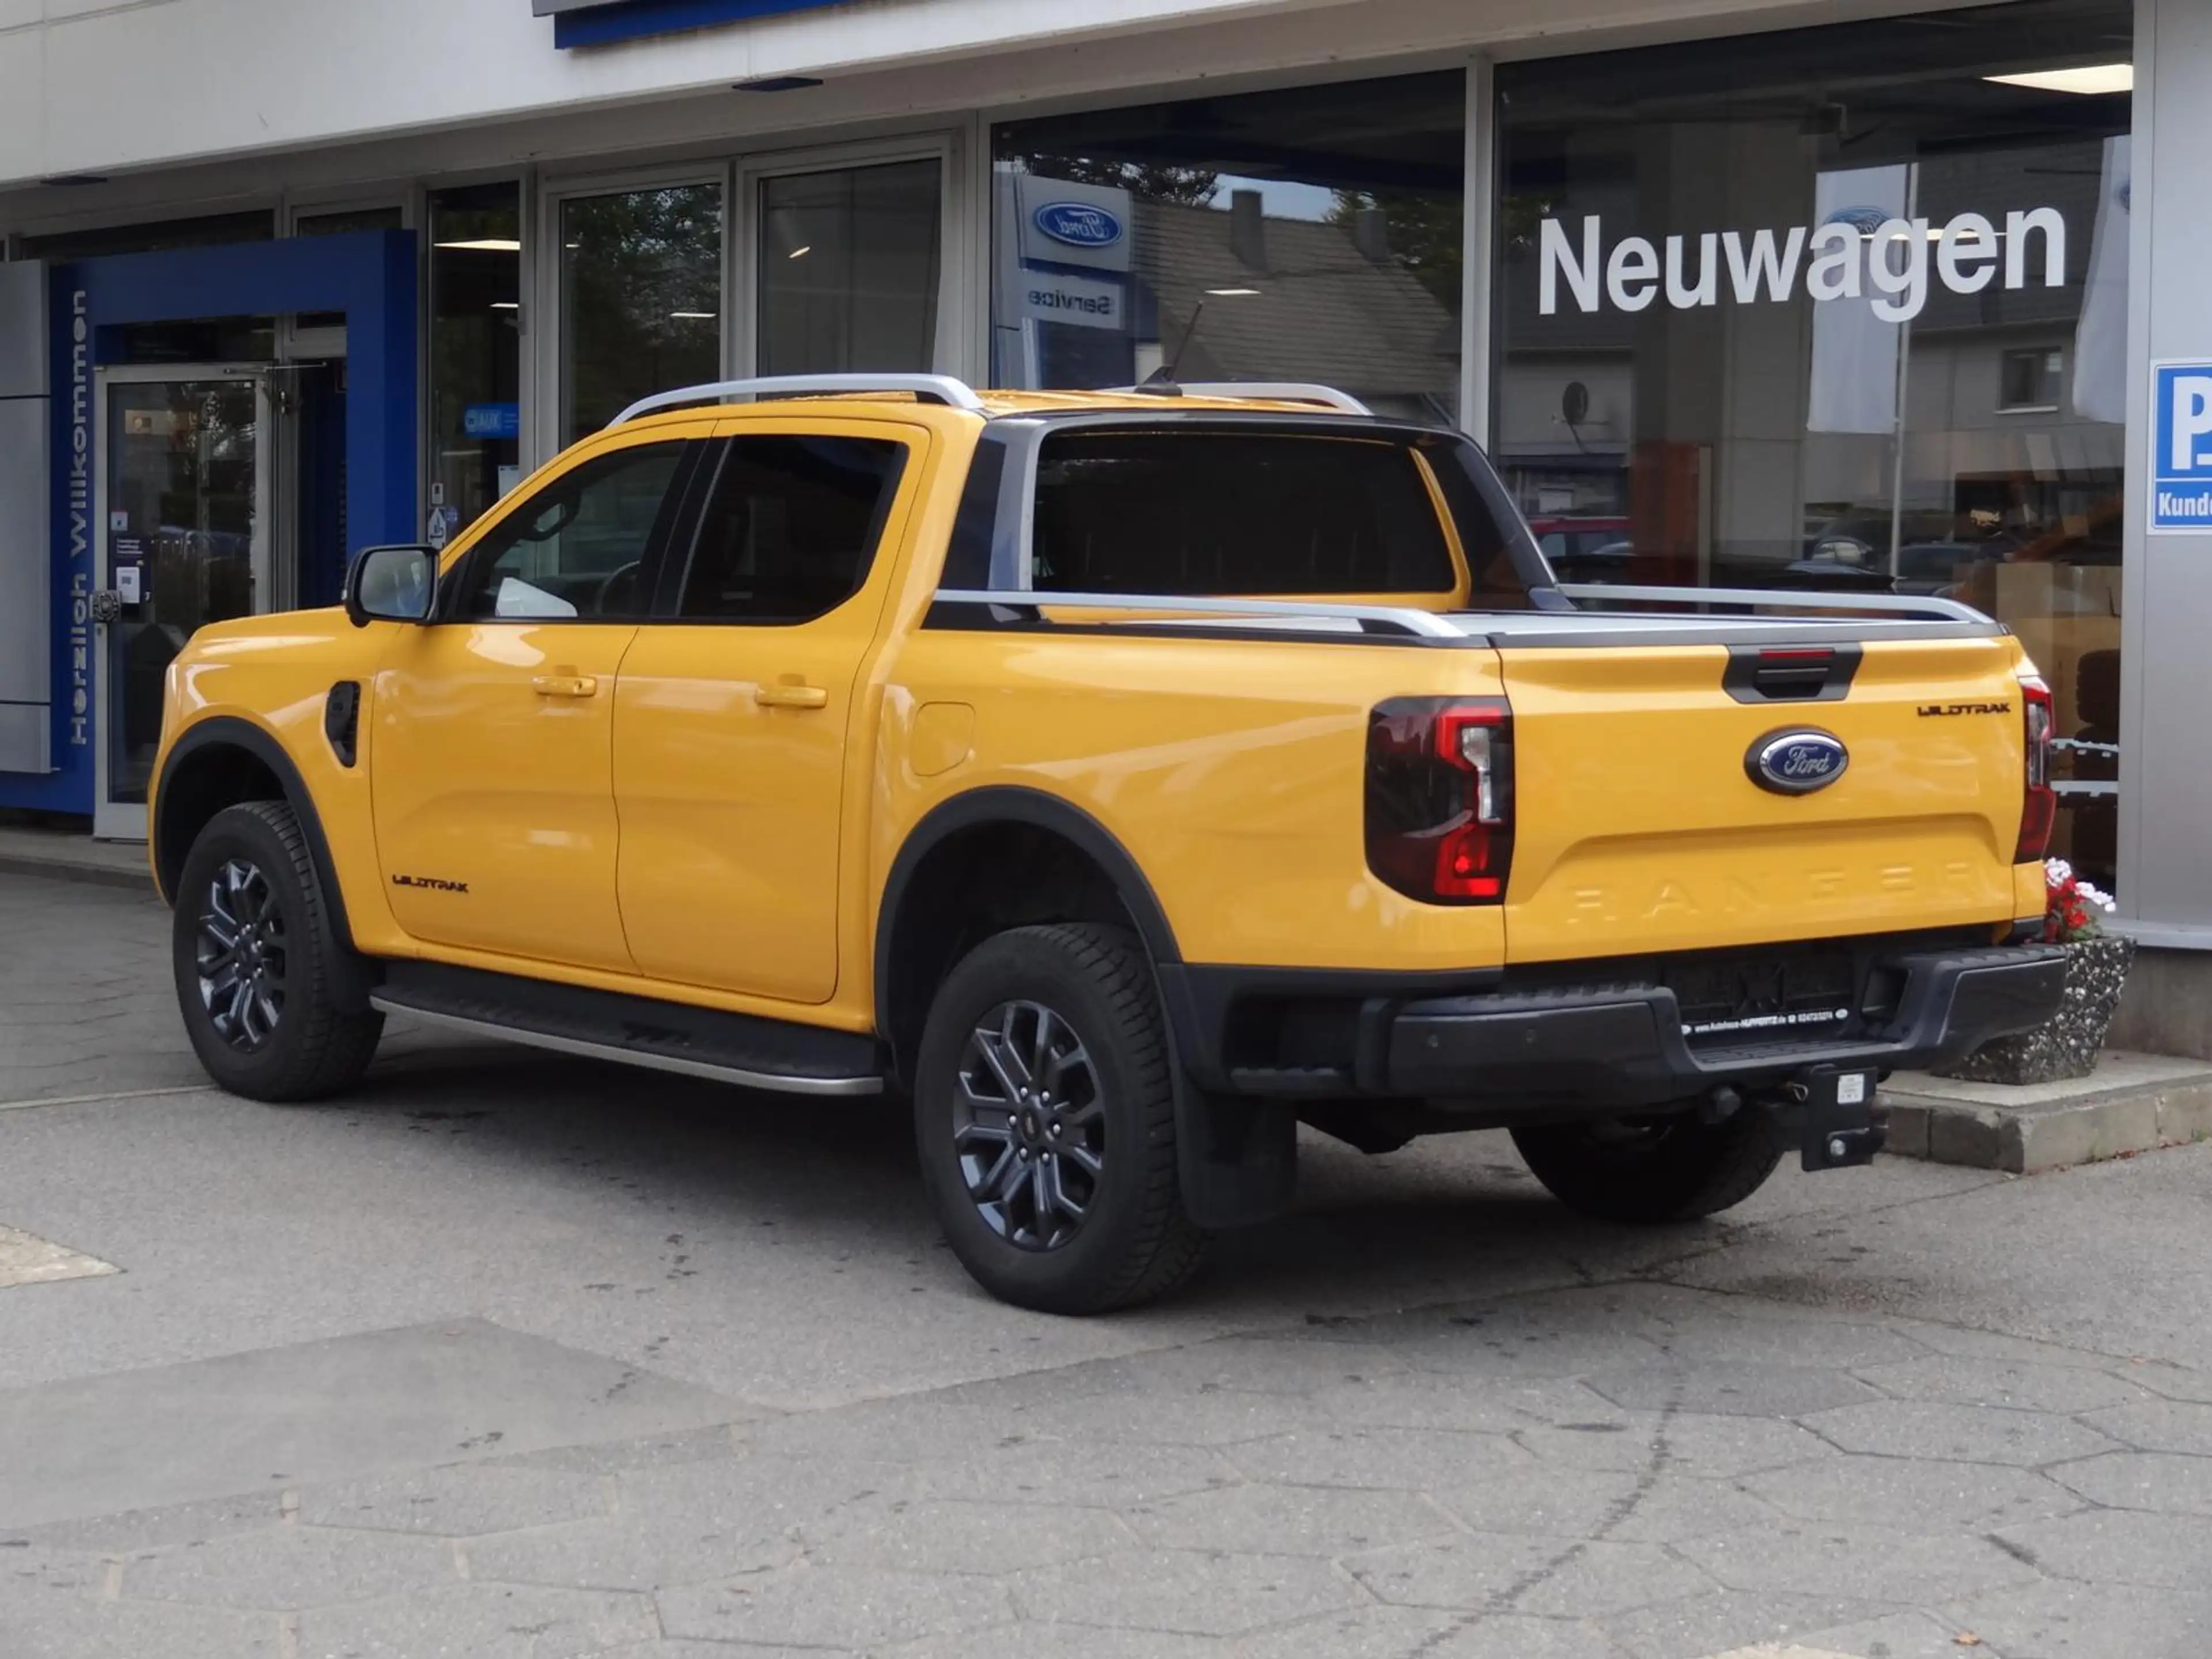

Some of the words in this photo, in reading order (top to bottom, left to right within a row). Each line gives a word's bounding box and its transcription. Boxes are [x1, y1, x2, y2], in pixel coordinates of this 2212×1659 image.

[1539, 206, 2065, 323] Neuwagen
[70, 290, 87, 558] Willkommen
[2171, 376, 2212, 470] P
[2158, 492, 2212, 516] Kund
[70, 574, 86, 745] Herzlich
[1784, 745, 1830, 774] Ford
